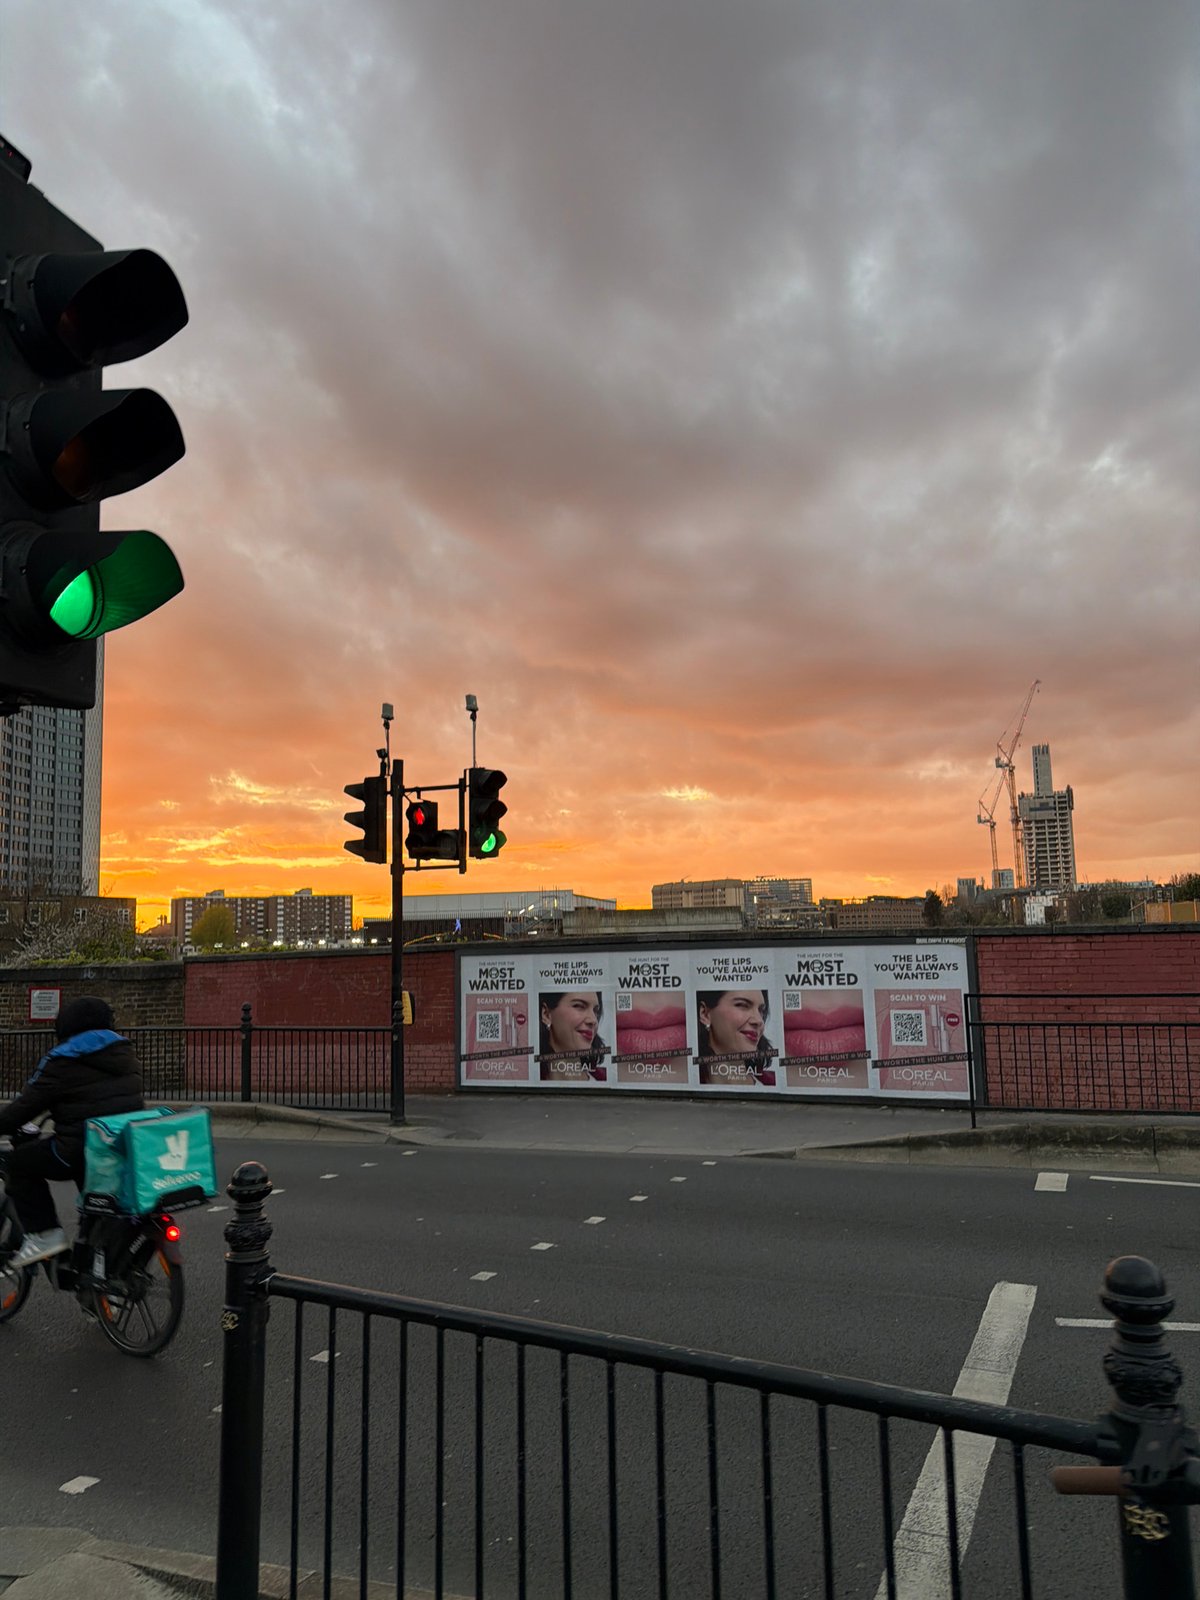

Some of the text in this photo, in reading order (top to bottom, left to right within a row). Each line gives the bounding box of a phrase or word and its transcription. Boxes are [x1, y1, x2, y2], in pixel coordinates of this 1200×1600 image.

[712, 957, 752, 966] THE LIPS
[892, 954, 938, 962] THE LIPS
[571, 961, 588, 969] LIPS
[629, 963, 670, 976] MOST
[696, 965, 769, 974] YOU'VE ALWAYS
[797, 959, 844, 973] MOST
[874, 963, 959, 972] YOU'VE ALWAYS
[479, 967, 515, 979] MOST
[539, 970, 569, 978] YOU'VE
[713, 974, 753, 982] WANTED
[893, 972, 940, 980] WANTED
[554, 977, 589, 985] WANTED
[618, 976, 682, 989] WANTED
[785, 973, 858, 986] WANTED
[469, 980, 525, 991] WANTED
[890, 994, 911, 1002] SCAN
[928, 994, 946, 1002] WIN
[550, 1061, 596, 1072] L'ORÉAL
[628, 1063, 676, 1074] L'ORÉAL
[711, 1064, 763, 1076] L'ORÉAL
[799, 1066, 855, 1078] L'ORÉAL
[893, 1068, 953, 1081] L'ORÉAL
